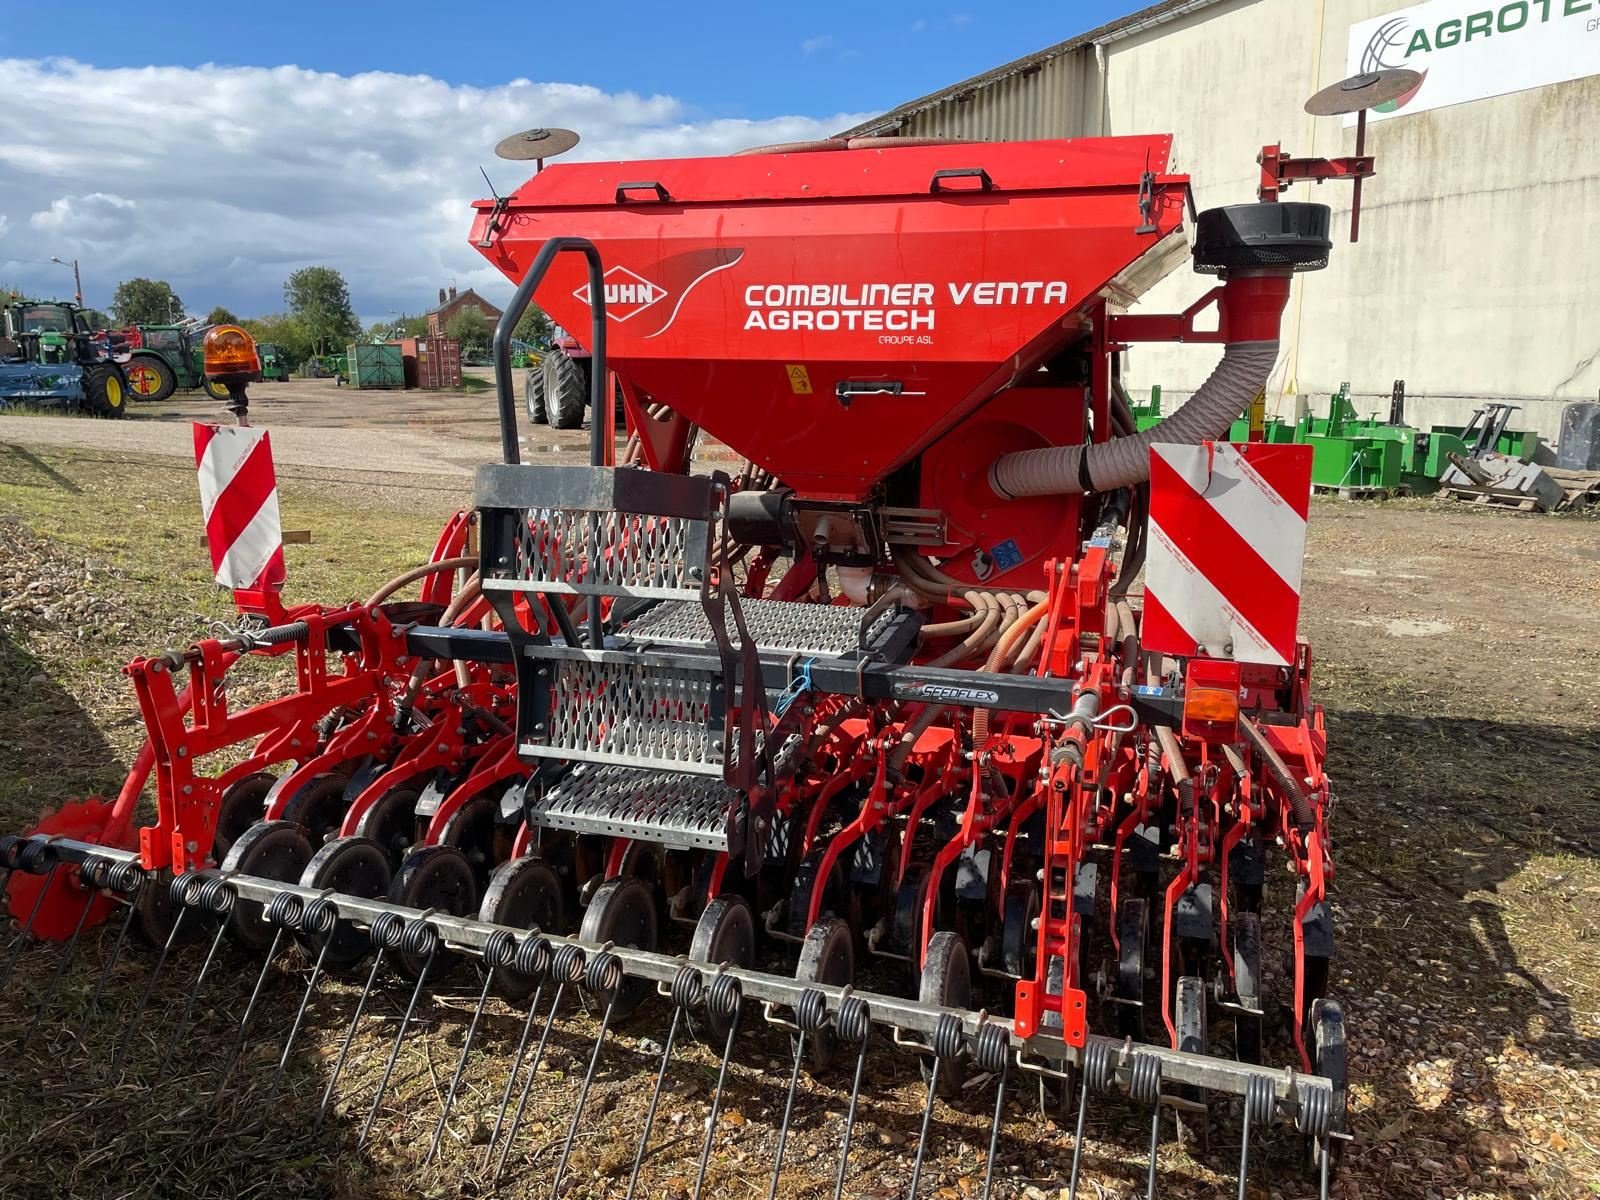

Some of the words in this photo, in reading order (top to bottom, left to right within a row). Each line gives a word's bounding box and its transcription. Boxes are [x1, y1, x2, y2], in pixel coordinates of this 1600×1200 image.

[1404, 0, 1600, 58] AGROTE
[745, 284, 935, 307] COMBILINER
[949, 281, 1068, 305] VENTA
[744, 309, 935, 331] AGROTECH
[916, 335, 934, 345] ASL
[922, 685, 995, 701] SEEDFLEX
